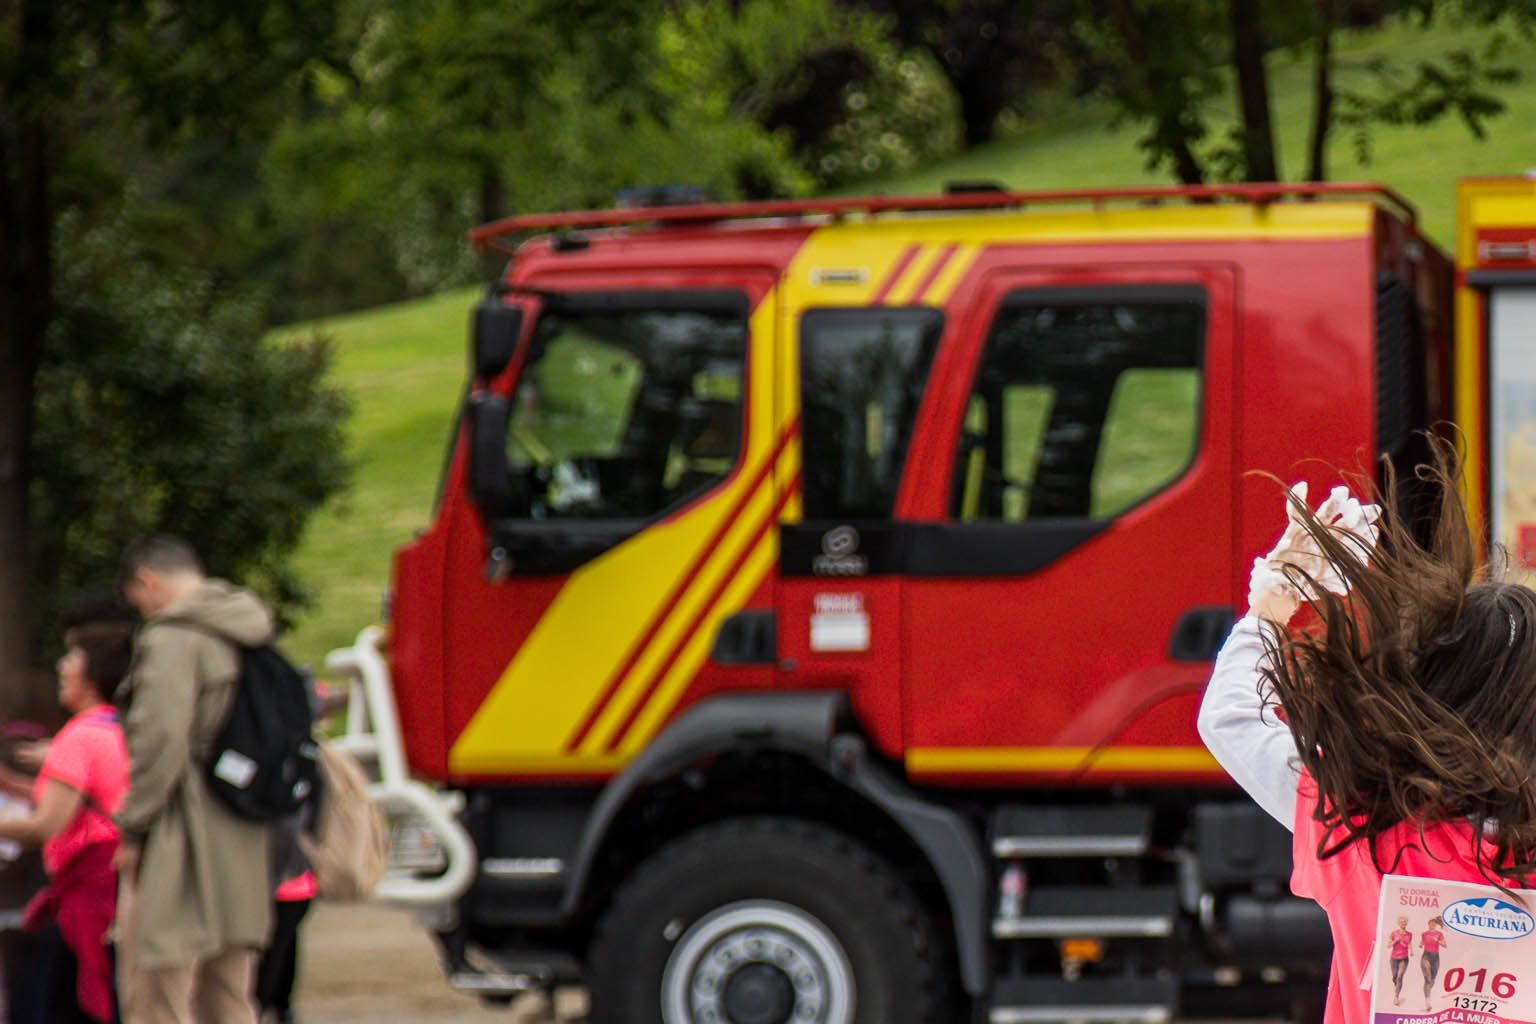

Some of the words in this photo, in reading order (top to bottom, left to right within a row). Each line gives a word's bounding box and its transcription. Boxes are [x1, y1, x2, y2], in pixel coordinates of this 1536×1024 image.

[1399, 895, 1440, 909] SUMA
[1449, 907, 1528, 933] ASTURIANA
[1443, 967, 1517, 999] 016
[1453, 996, 1498, 1015] 13172
[1439, 1011, 1449, 1023] DE
[1450, 1010, 1465, 1022] LA
